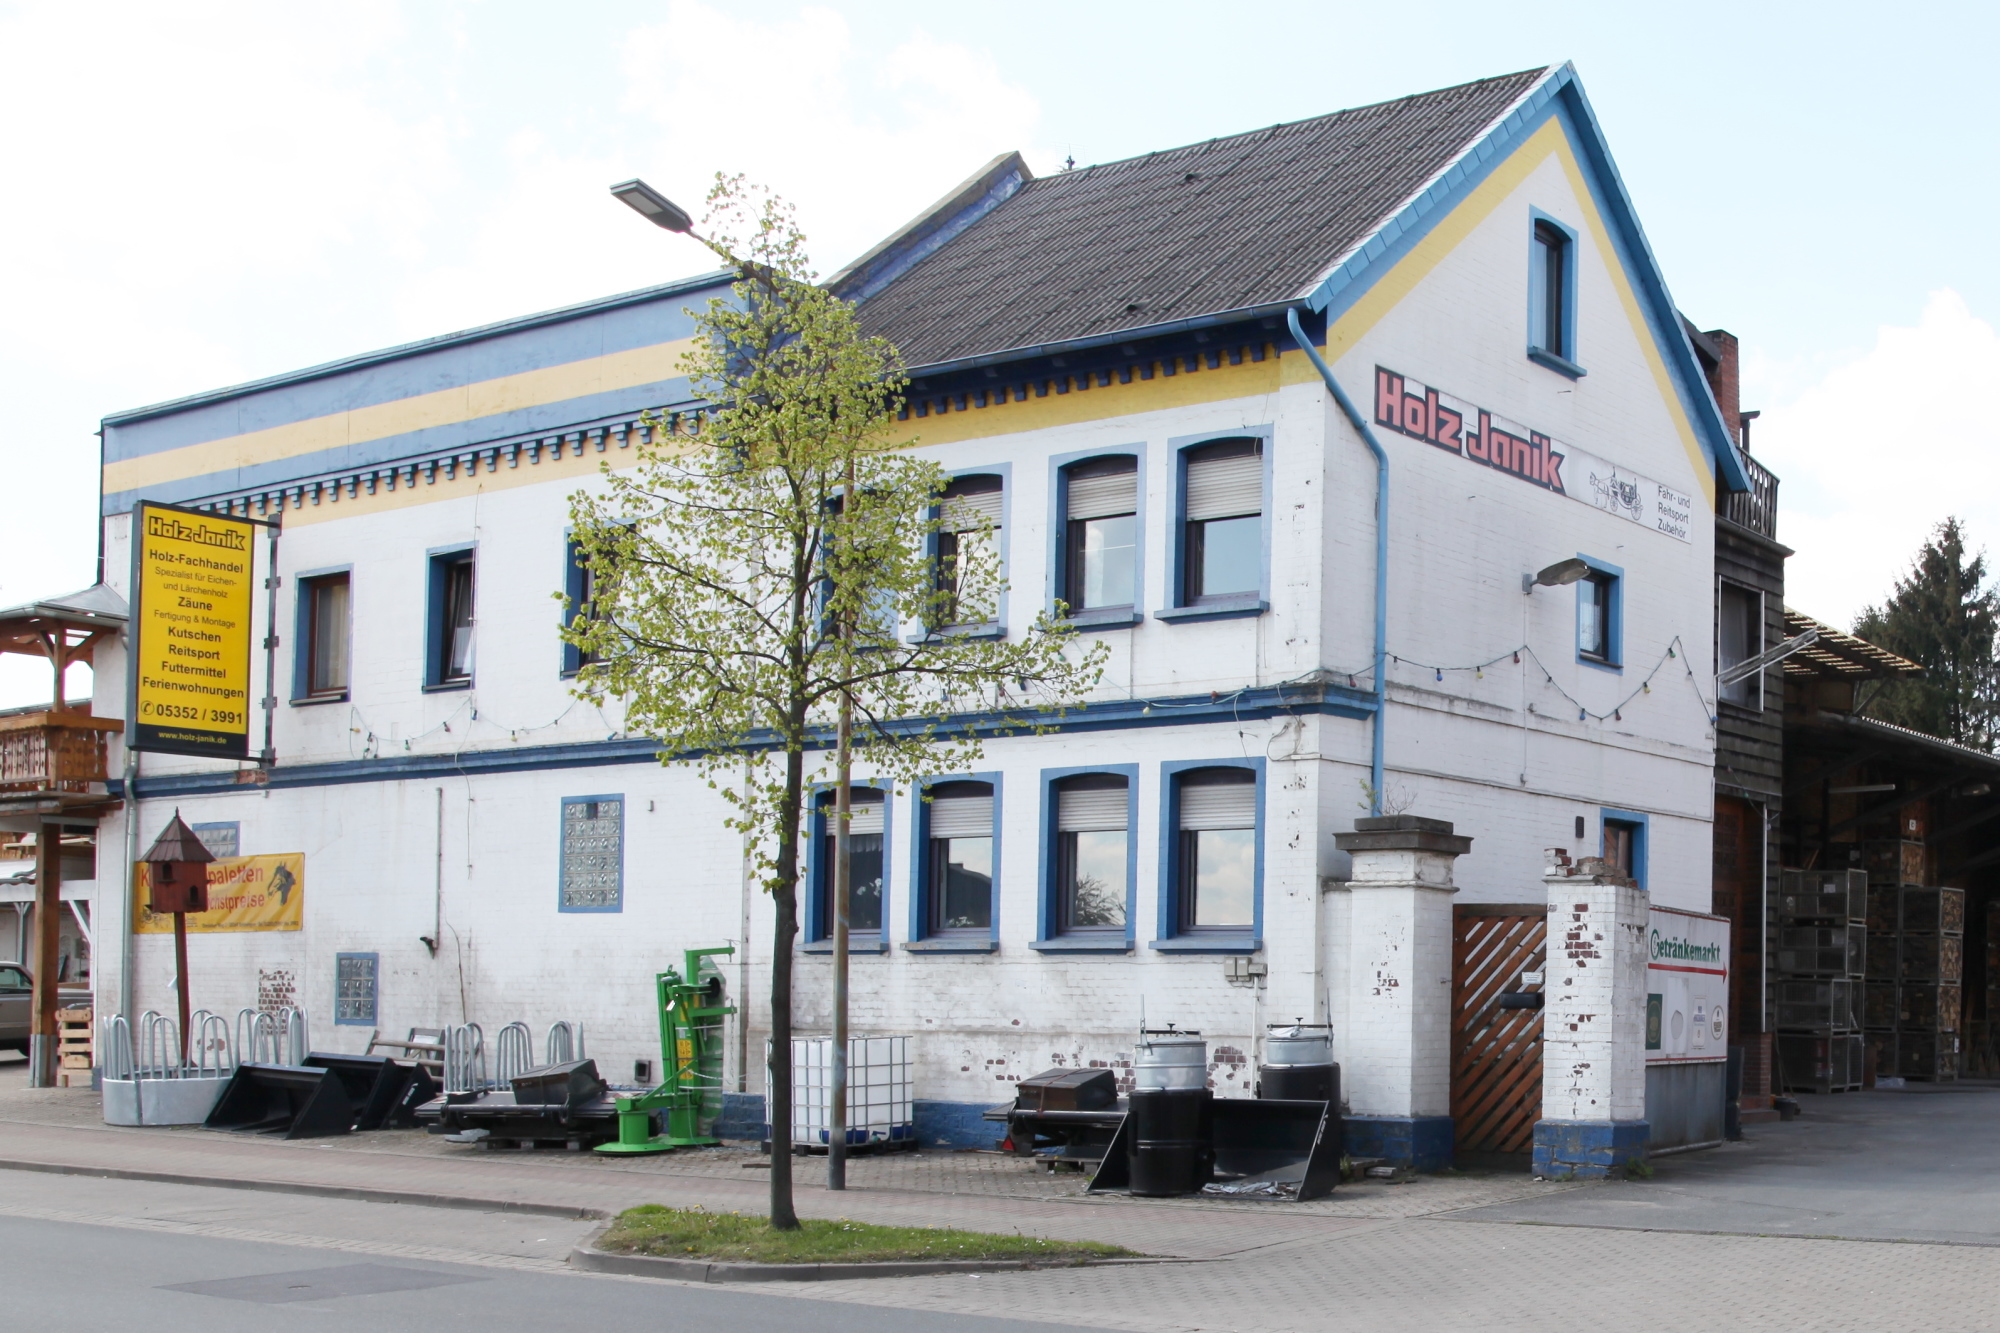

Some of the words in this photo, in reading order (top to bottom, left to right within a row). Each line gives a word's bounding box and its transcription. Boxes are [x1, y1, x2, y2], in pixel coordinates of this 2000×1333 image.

[1465, 407, 1567, 496] Janik
[1658, 485, 1676, 502] Fahr-
[1677, 496, 1691, 509] und
[1658, 501, 1689, 525] Reitsport
[193, 524, 246, 551] Janik
[1658, 517, 1686, 539] Zubehör
[149, 549, 244, 573] Holz-Fachhandel
[154, 566, 193, 580] Spezialist
[194, 572, 206, 582] für
[207, 574, 237, 586] Eichen-
[163, 582, 178, 591] und
[180, 583, 229, 599] Lärchenholz
[178, 596, 213, 611] Zäune
[154, 609, 192, 624] Fertigung
[193, 614, 200, 623] &
[201, 616, 236, 629] Montage
[168, 626, 222, 643] Kutschen
[168, 643, 221, 661] Reitsport
[161, 660, 227, 679] Futtermittel
[142, 676, 245, 699] Ferienwohnungen
[156, 703, 199, 720] 05352
[201, 708, 207, 721] /
[210, 709, 243, 725] 3991
[158, 731, 228, 744] www.holz-janik.de
[1651, 929, 1720, 962] Getränkemarkt
